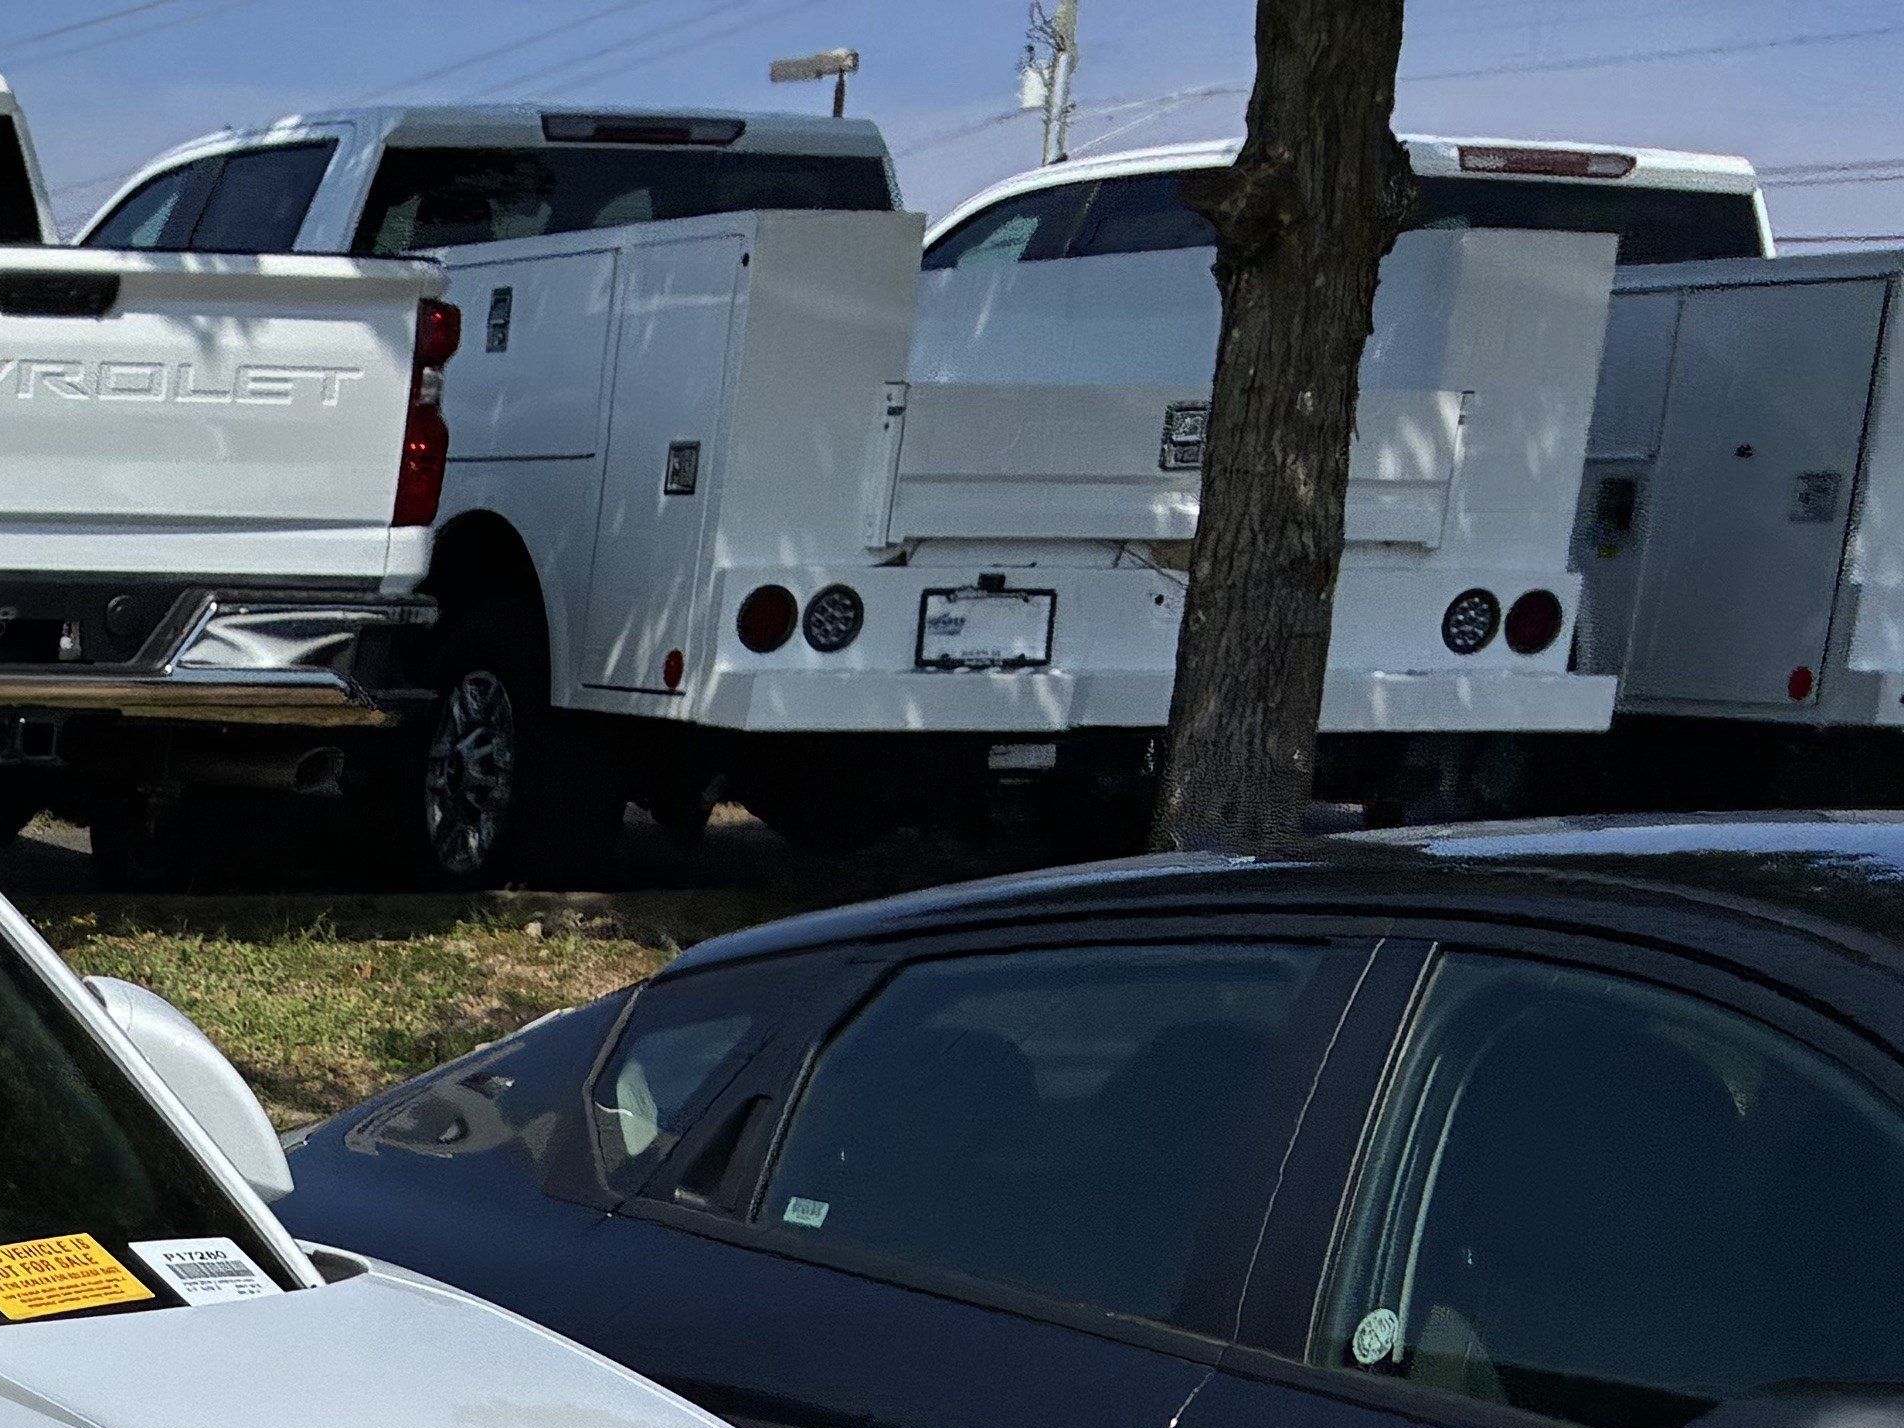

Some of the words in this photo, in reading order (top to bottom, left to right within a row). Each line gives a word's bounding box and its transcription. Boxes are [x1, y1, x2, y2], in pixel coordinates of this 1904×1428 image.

[1, 1240, 69, 1262] VEHICLE
[70, 1237, 92, 1251] IS
[20, 1258, 57, 1276] FOR
[57, 1252, 100, 1269] SALE
